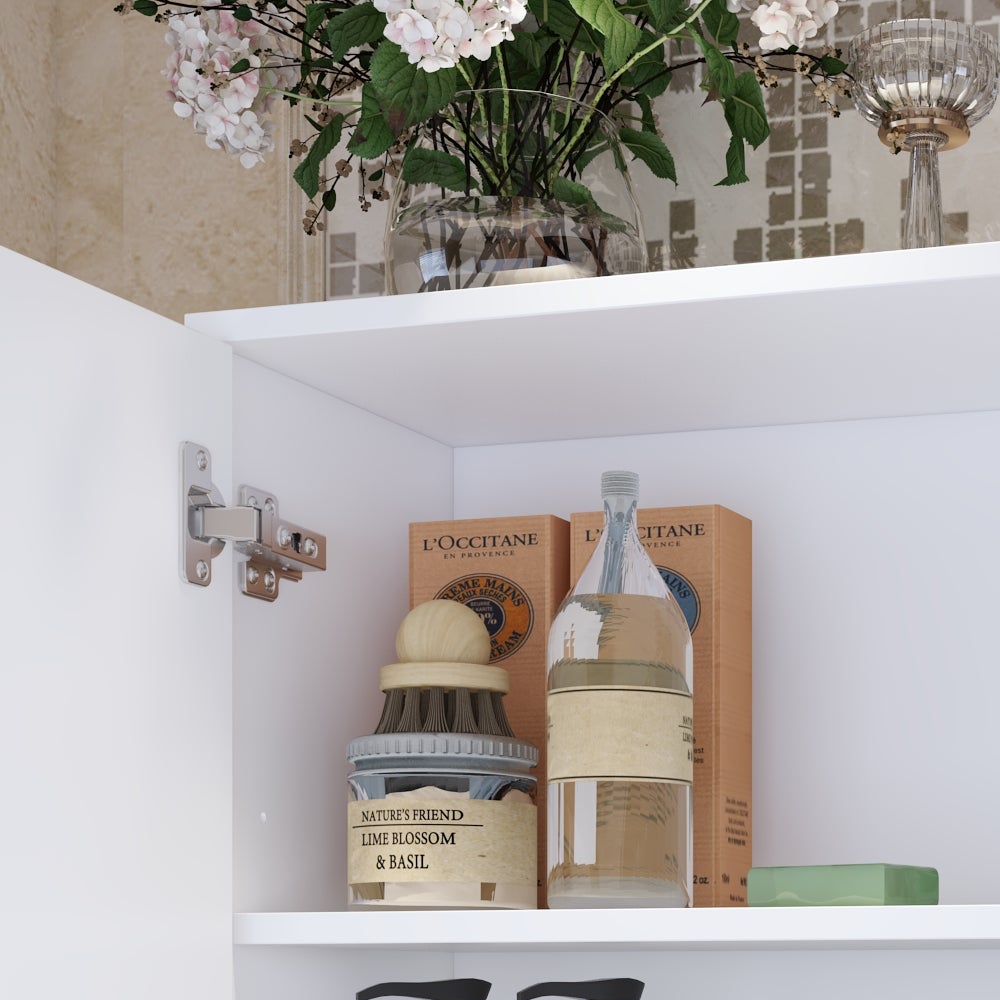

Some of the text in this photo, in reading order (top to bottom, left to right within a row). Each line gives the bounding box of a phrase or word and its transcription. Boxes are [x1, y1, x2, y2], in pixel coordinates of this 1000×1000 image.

[585, 523, 706, 542] L'CITANE
[423, 533, 539, 551] L'OCCITANE
[461, 550, 515, 559] PROVENCE
[443, 579, 524, 606] REME MAINS
[661, 571, 690, 599] AINS
[455, 589, 477, 603] EAUX
[361, 808, 464, 822] NATURE'S FRIEND
[361, 831, 457, 846] LIME BLOSSOM
[376, 854, 429, 870] & BASIL
